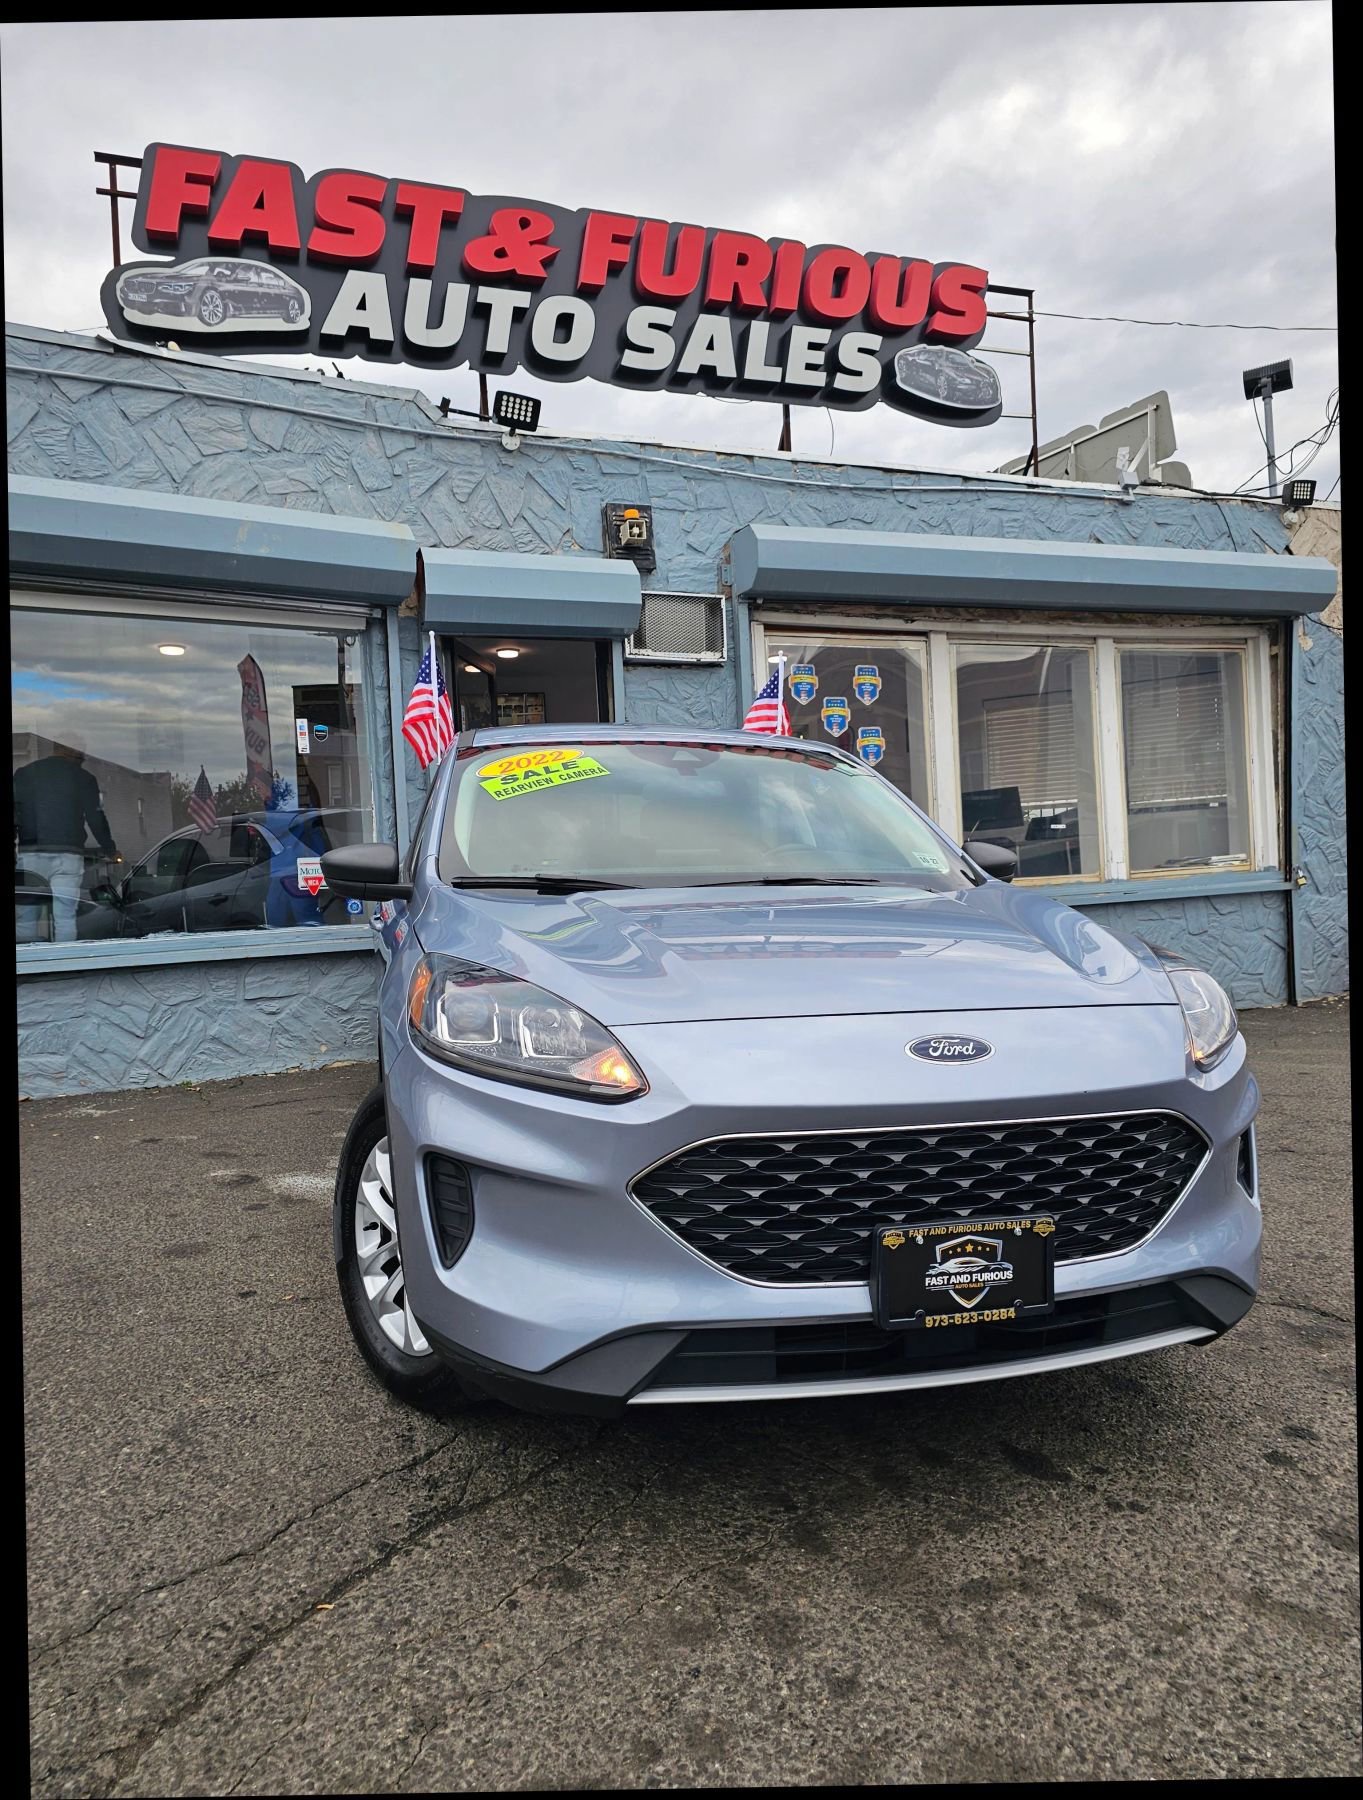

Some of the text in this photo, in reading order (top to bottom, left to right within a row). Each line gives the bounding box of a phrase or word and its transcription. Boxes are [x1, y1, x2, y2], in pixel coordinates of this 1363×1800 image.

[144, 145, 989, 340] FAST & FURIOUS
[319, 268, 884, 394] AUTO SALES
[498, 750, 566, 774] 2022
[500, 760, 579, 785] SALE
[494, 766, 606, 798] REARVIEW CAMERA
[929, 1039, 976, 1056] Ford
[908, 1228, 928, 1238] FAST
[929, 1226, 947, 1236] AND
[948, 1223, 983, 1234] FURIOUS
[983, 1222, 1005, 1231] AUTO
[1006, 1220, 1031, 1230] SALES
[925, 1270, 1013, 1287] FAST AND FURIOUS
[925, 1307, 1016, 1328] 973-623-0284
